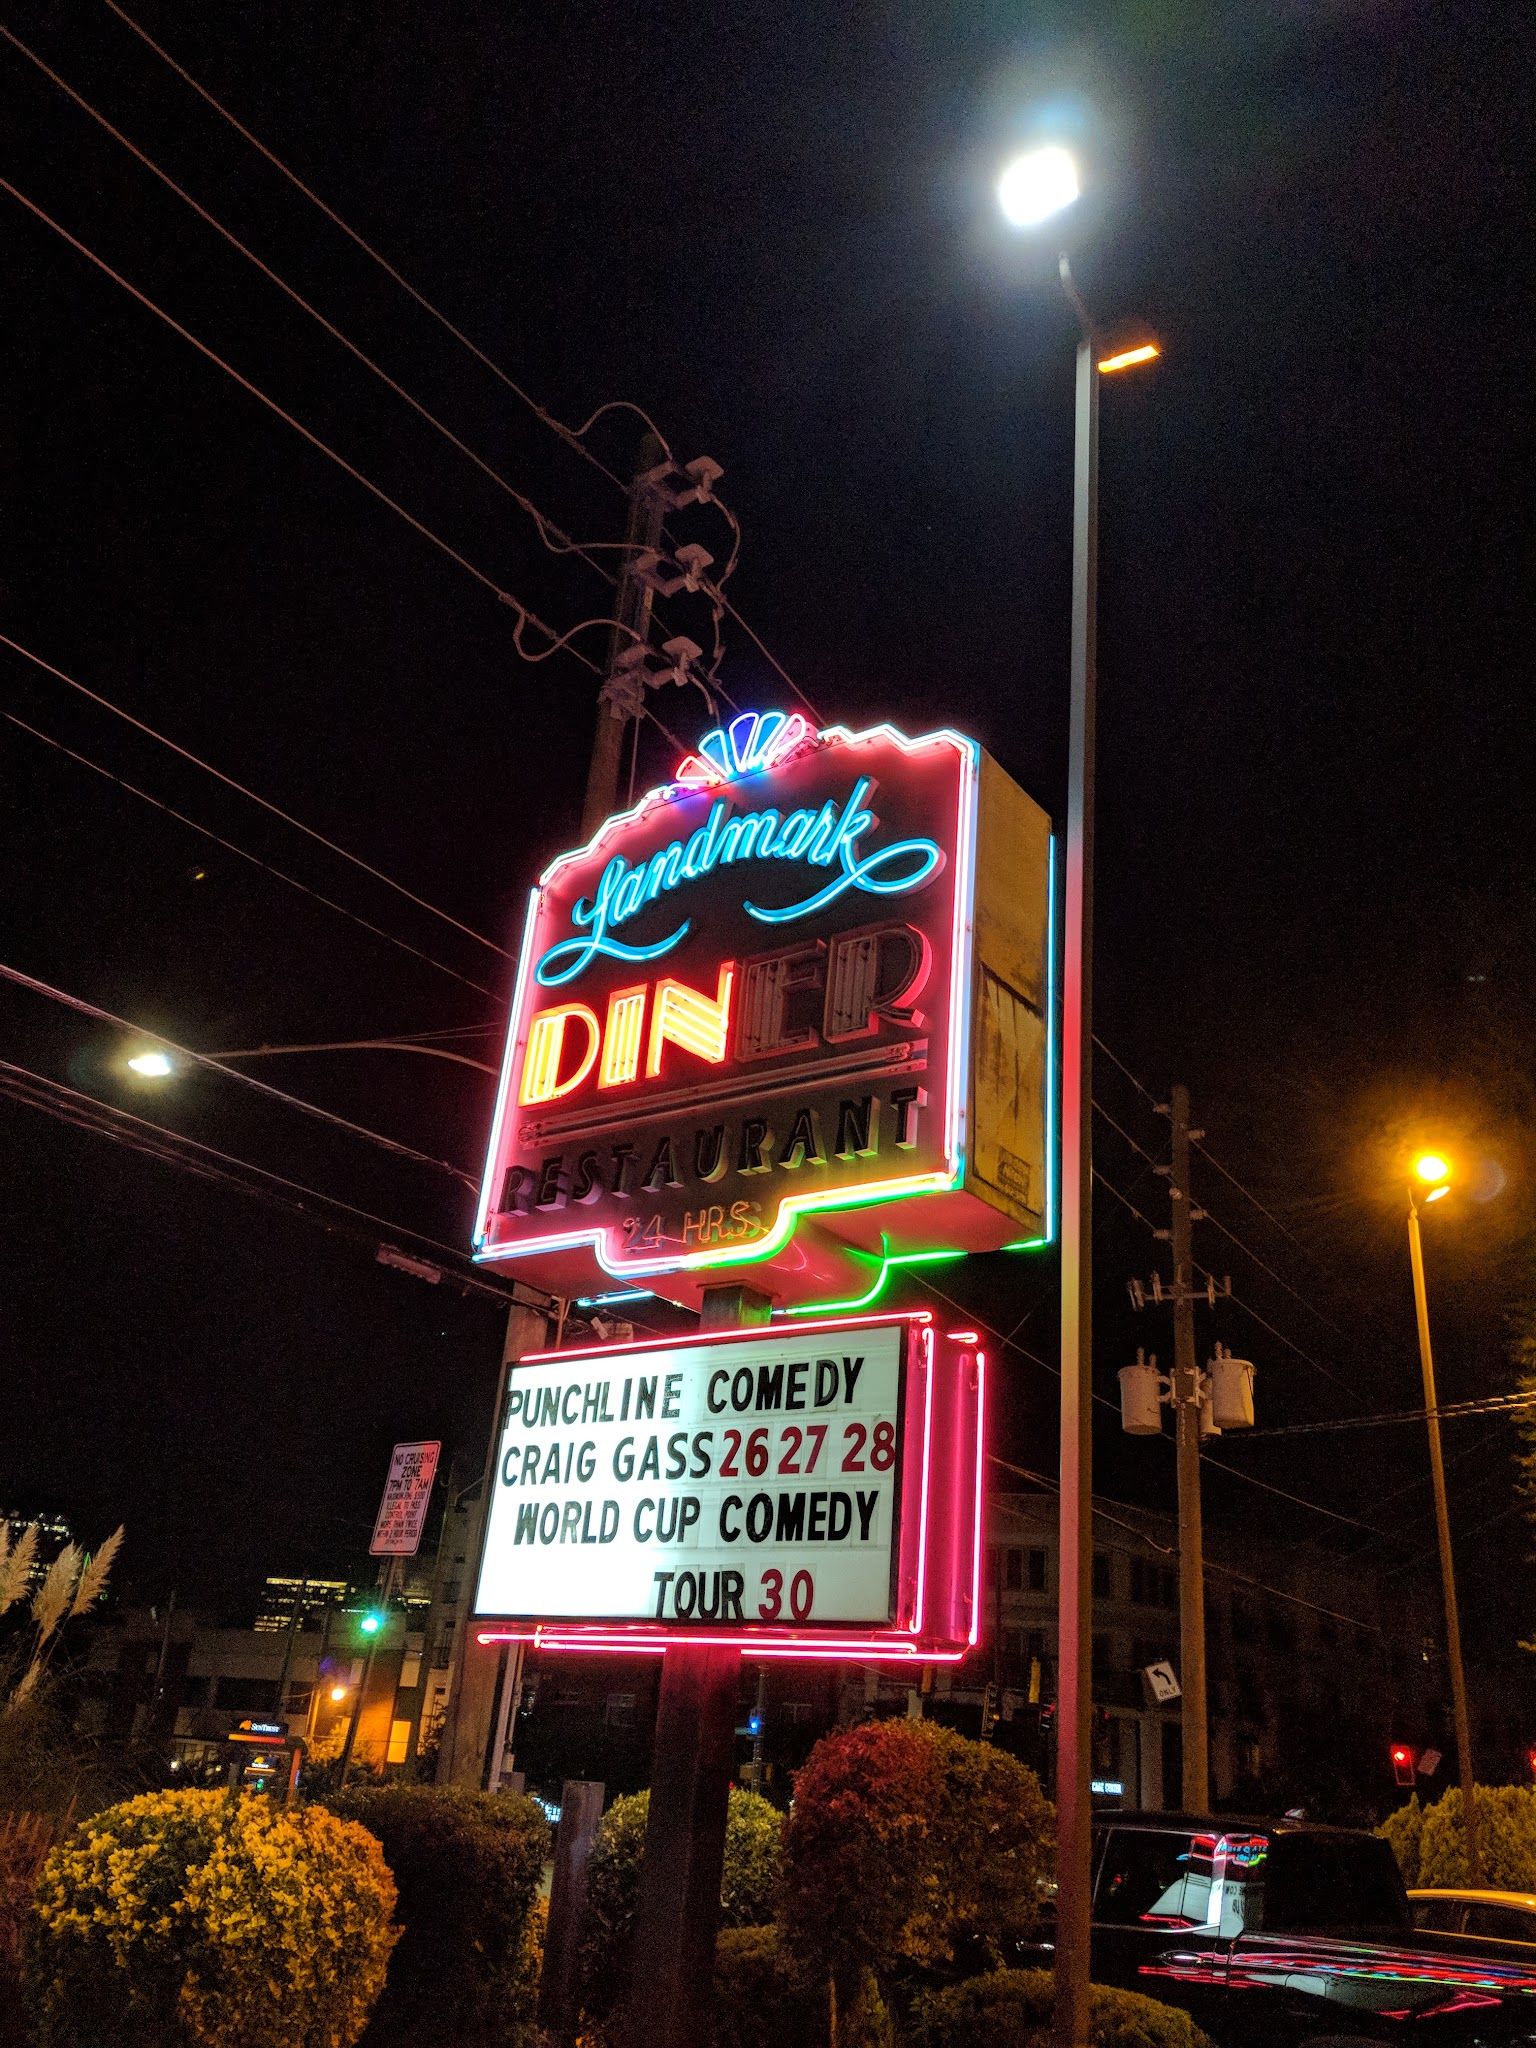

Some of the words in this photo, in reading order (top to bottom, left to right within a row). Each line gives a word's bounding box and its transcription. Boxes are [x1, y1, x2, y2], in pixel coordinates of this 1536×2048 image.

[535, 775, 948, 987] Landmark
[518, 922, 938, 1110] DINER
[497, 1086, 928, 1217] RESTAURANT
[622, 1216, 661, 1251] 24
[683, 1200, 761, 1244] HRS
[505, 1373, 684, 1430] PUNCHLINE
[707, 1357, 865, 1414] COMEDY
[395, 1454, 404, 1465] NO
[405, 1451, 435, 1465] CRUISING
[401, 1465, 423, 1478] ZONE
[502, 1440, 597, 1487] CRAIG
[612, 1431, 711, 1483] GASS
[718, 1427, 769, 1478] 26
[778, 1423, 827, 1476] 27
[841, 1420, 896, 1473] 28
[389, 1479, 403, 1491] 7PM
[404, 1479, 413, 1490] TO
[414, 1478, 429, 1490] 7AM
[513, 1499, 620, 1546] WORLD
[633, 1495, 700, 1544] CUP
[719, 1490, 879, 1544] COMEDY
[653, 1570, 746, 1620] TOUR
[758, 1569, 814, 1621] 30
